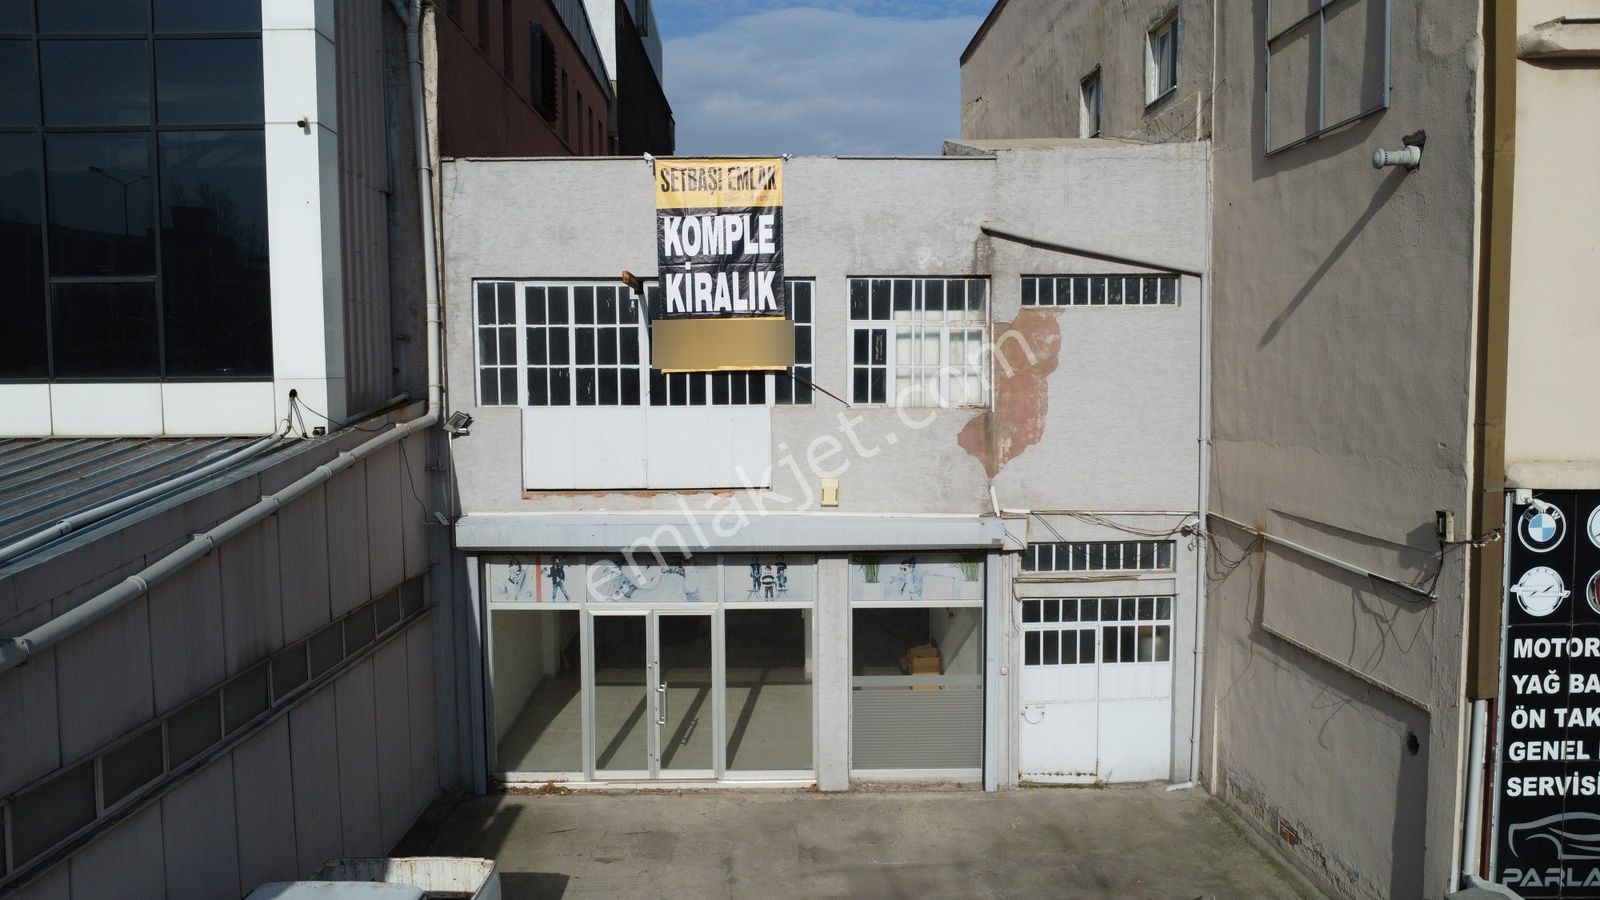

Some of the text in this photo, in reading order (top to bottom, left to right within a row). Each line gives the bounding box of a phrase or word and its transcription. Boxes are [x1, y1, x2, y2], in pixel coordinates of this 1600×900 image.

[660, 165, 777, 195] SETBAŞI EMLAK
[664, 214, 776, 257] KOMPLE
[665, 261, 778, 313] KİRALIK
[1513, 637, 1600, 658] MOTOR
[1511, 669, 1600, 695] YAĞ BA
[1511, 705, 1600, 729] ÖN TAK
[1508, 740, 1590, 761] GENEL
